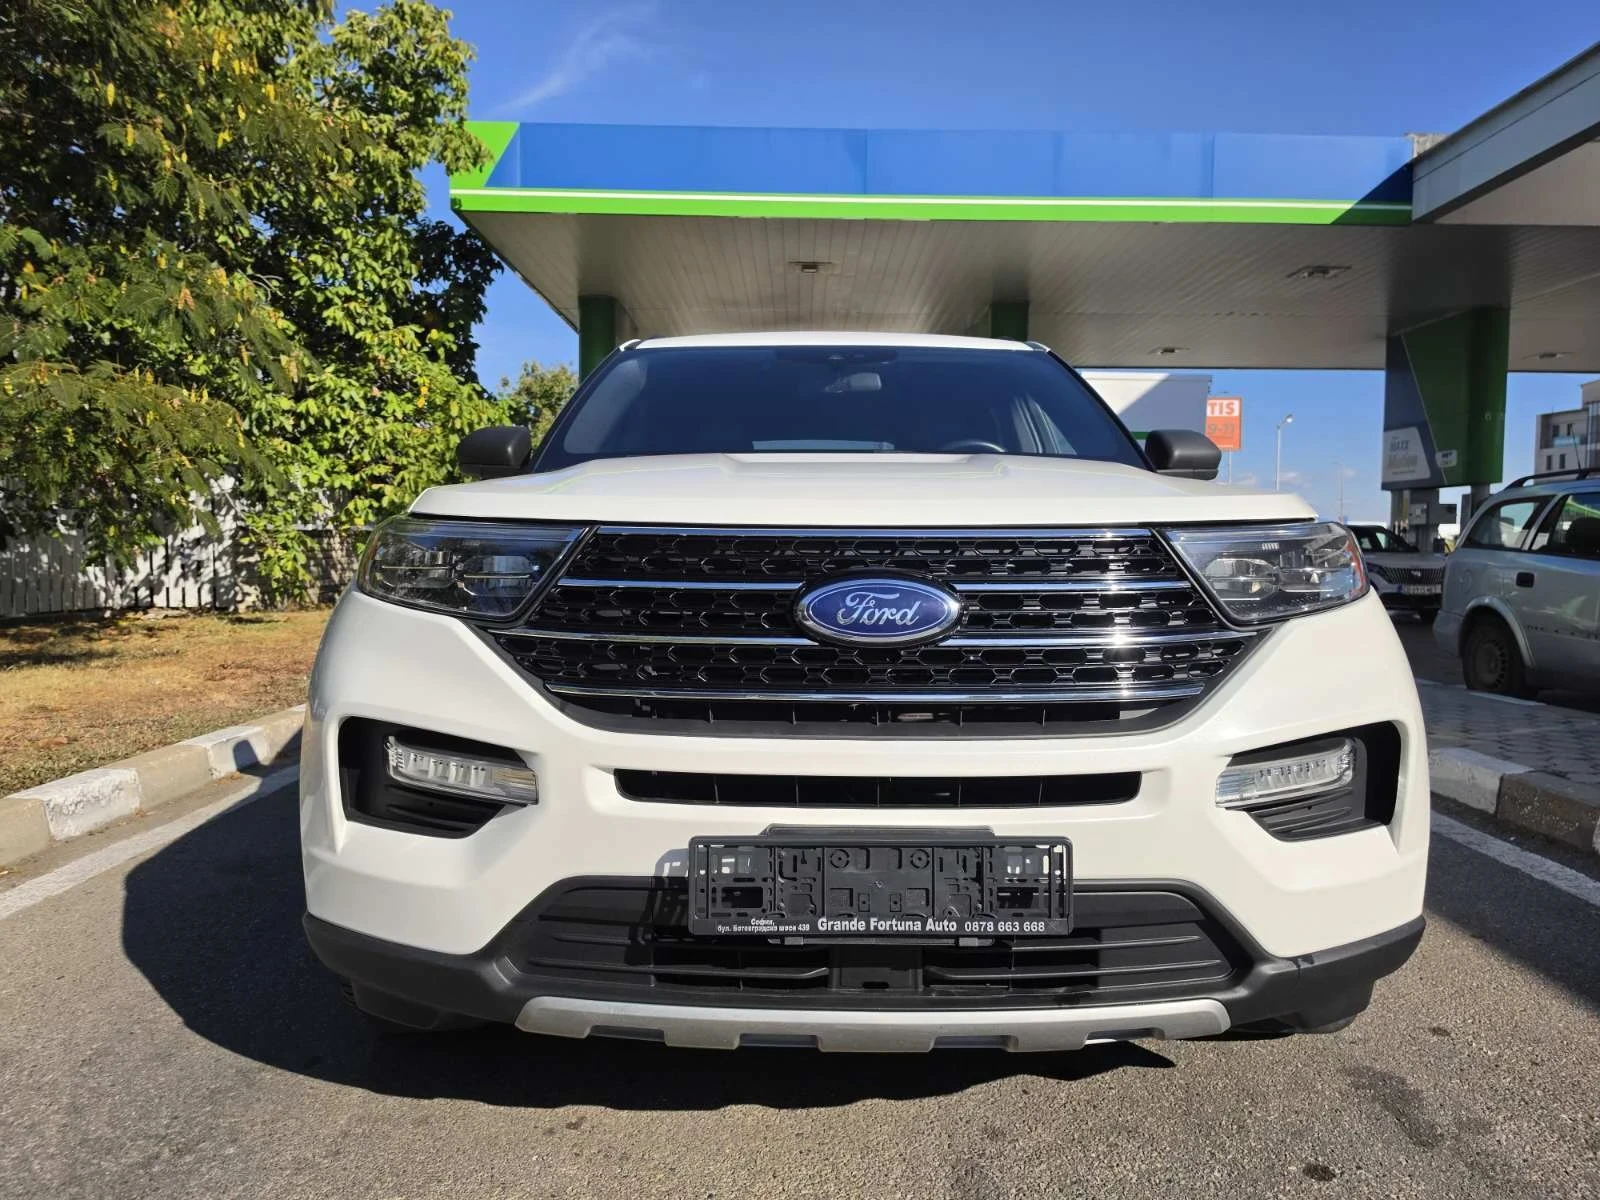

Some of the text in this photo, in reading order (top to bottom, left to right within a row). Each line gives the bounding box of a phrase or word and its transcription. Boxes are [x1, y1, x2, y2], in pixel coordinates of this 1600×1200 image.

[837, 592, 920, 625] Ford
[797, 923, 810, 931] 439
[817, 917, 1045, 932] Grande Fortuna Auto 0878 663 668
